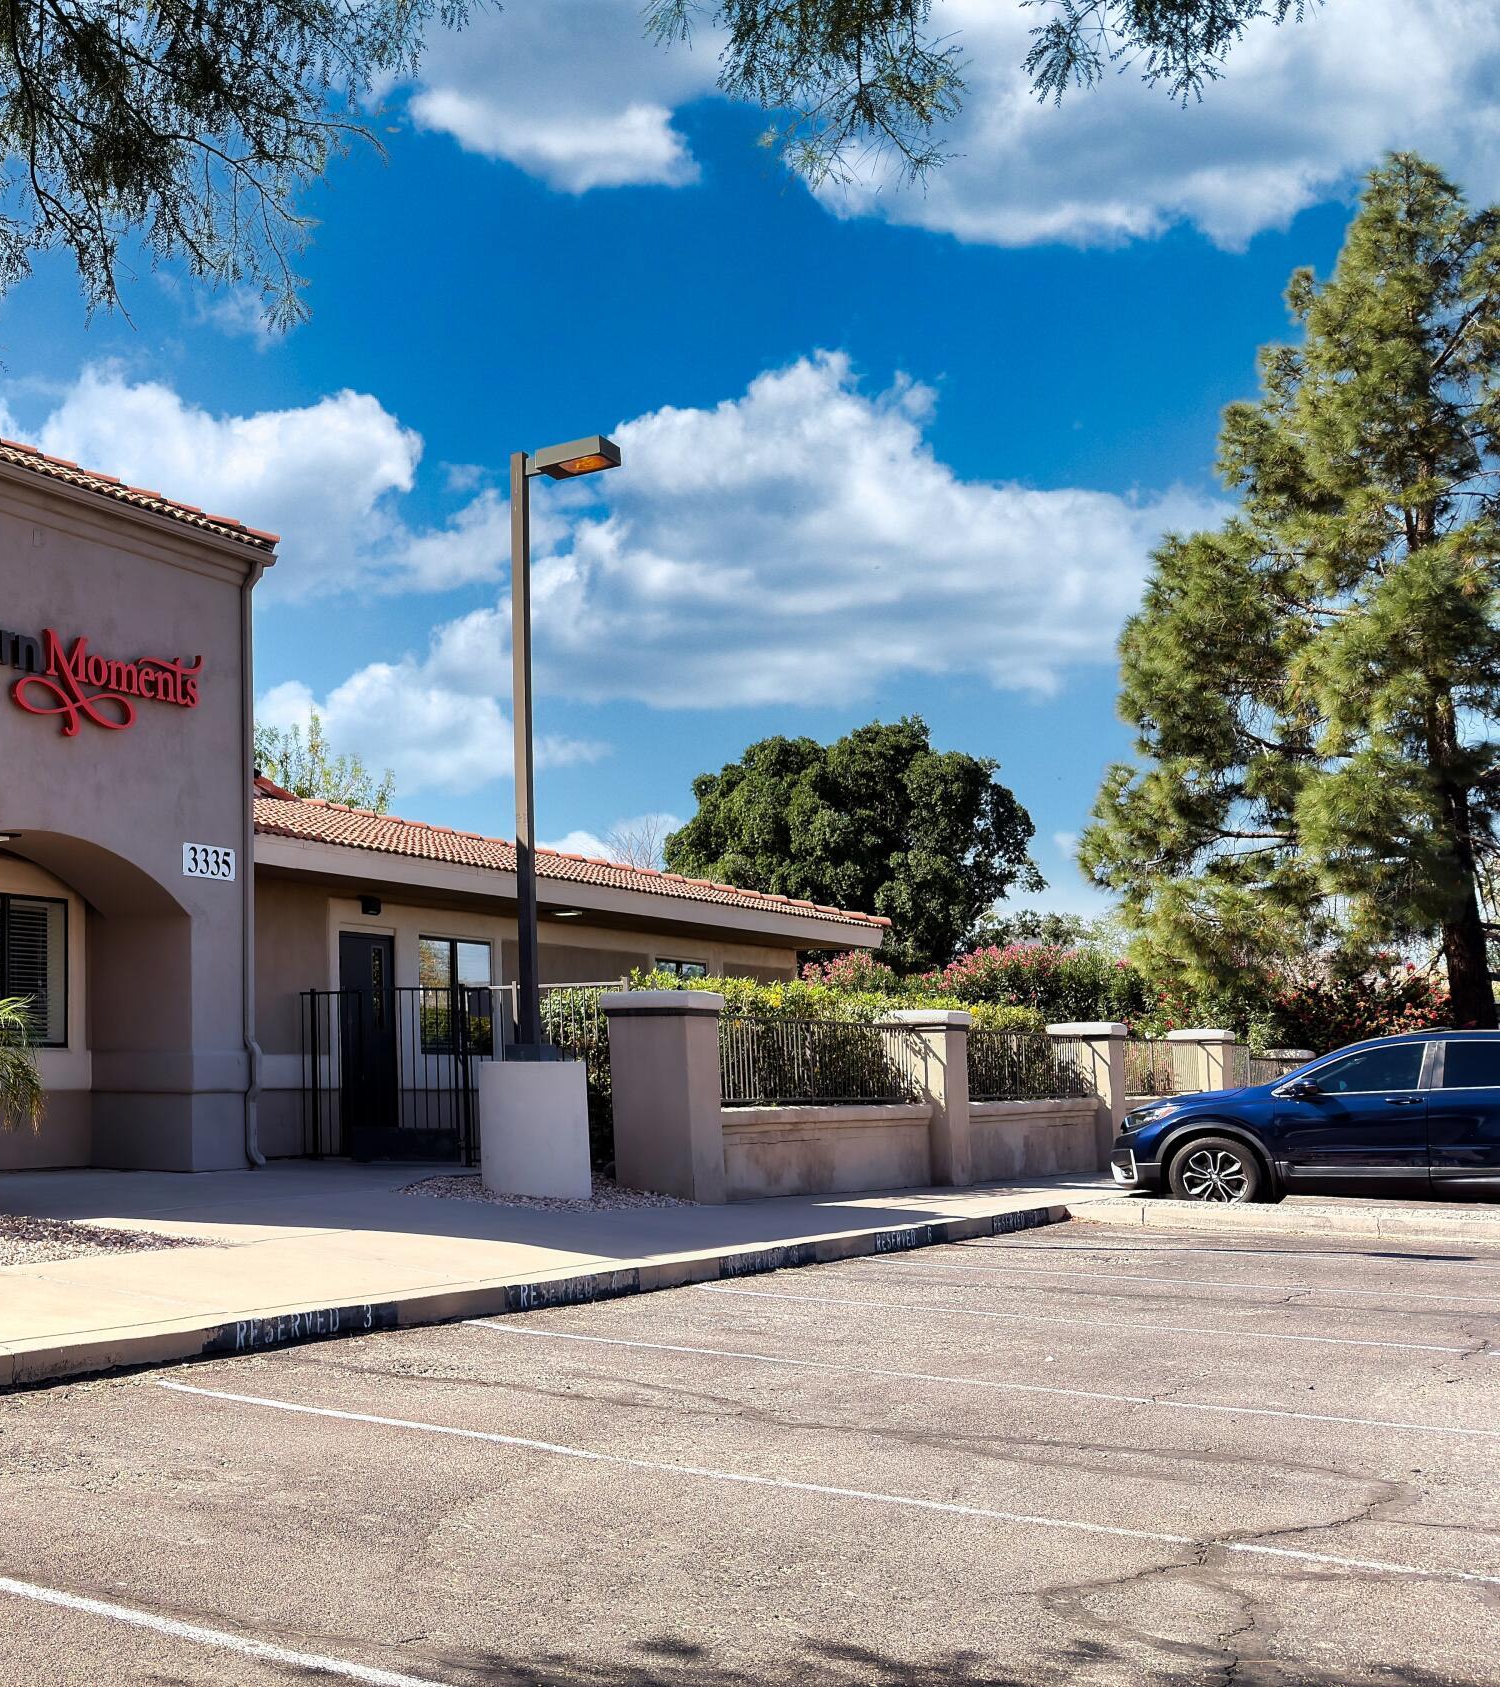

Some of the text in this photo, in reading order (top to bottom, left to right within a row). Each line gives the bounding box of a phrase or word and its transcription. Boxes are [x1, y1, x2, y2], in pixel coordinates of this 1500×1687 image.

[13, 628, 203, 737] Moments
[188, 846, 231, 877] 3335
[876, 1229, 916, 1251] RESERVED
[236, 1303, 373, 1350] RESERVED 3
